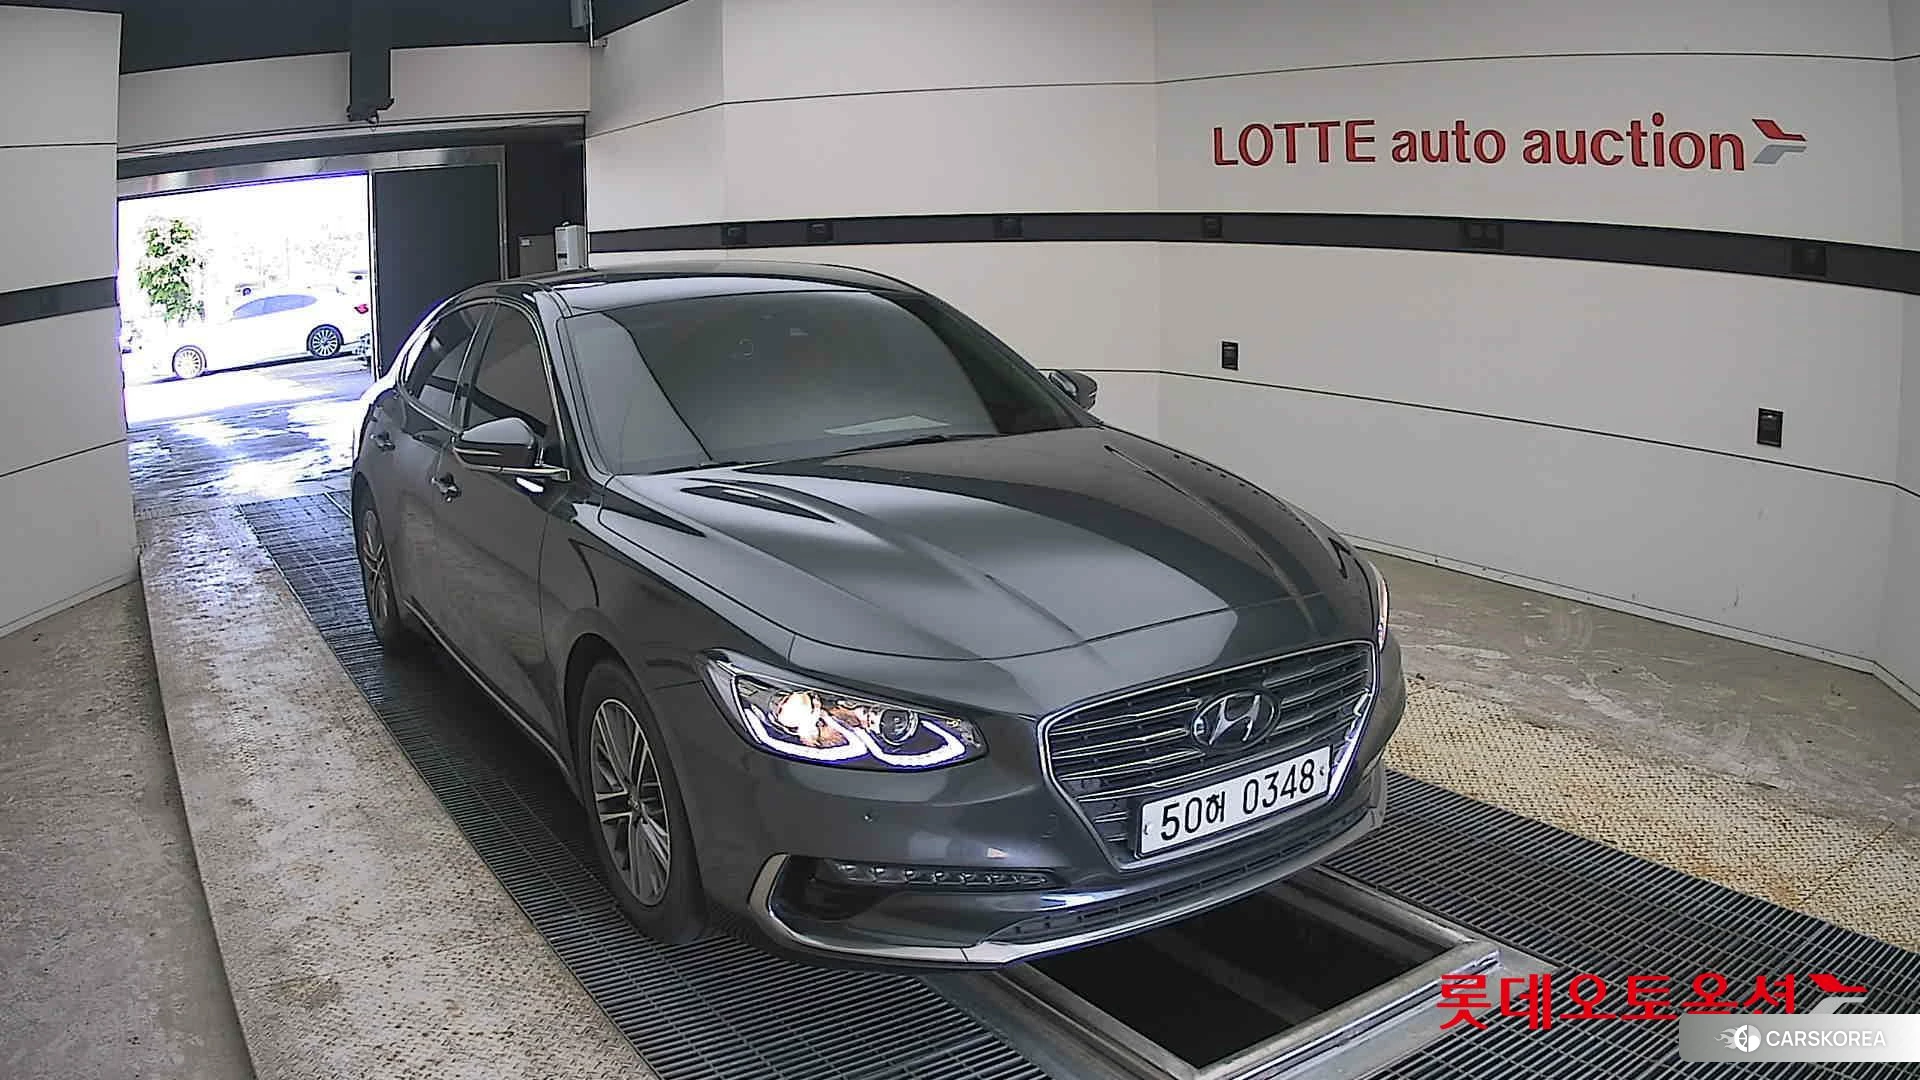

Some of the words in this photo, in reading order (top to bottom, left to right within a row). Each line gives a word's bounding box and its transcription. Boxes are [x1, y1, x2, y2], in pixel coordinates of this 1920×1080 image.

[1212, 119, 1376, 166] LOTTE
[1391, 119, 1507, 165] auto
[1522, 112, 1746, 172] auction
[1160, 790, 1226, 841] 50허
[1242, 758, 1316, 815] 0348
